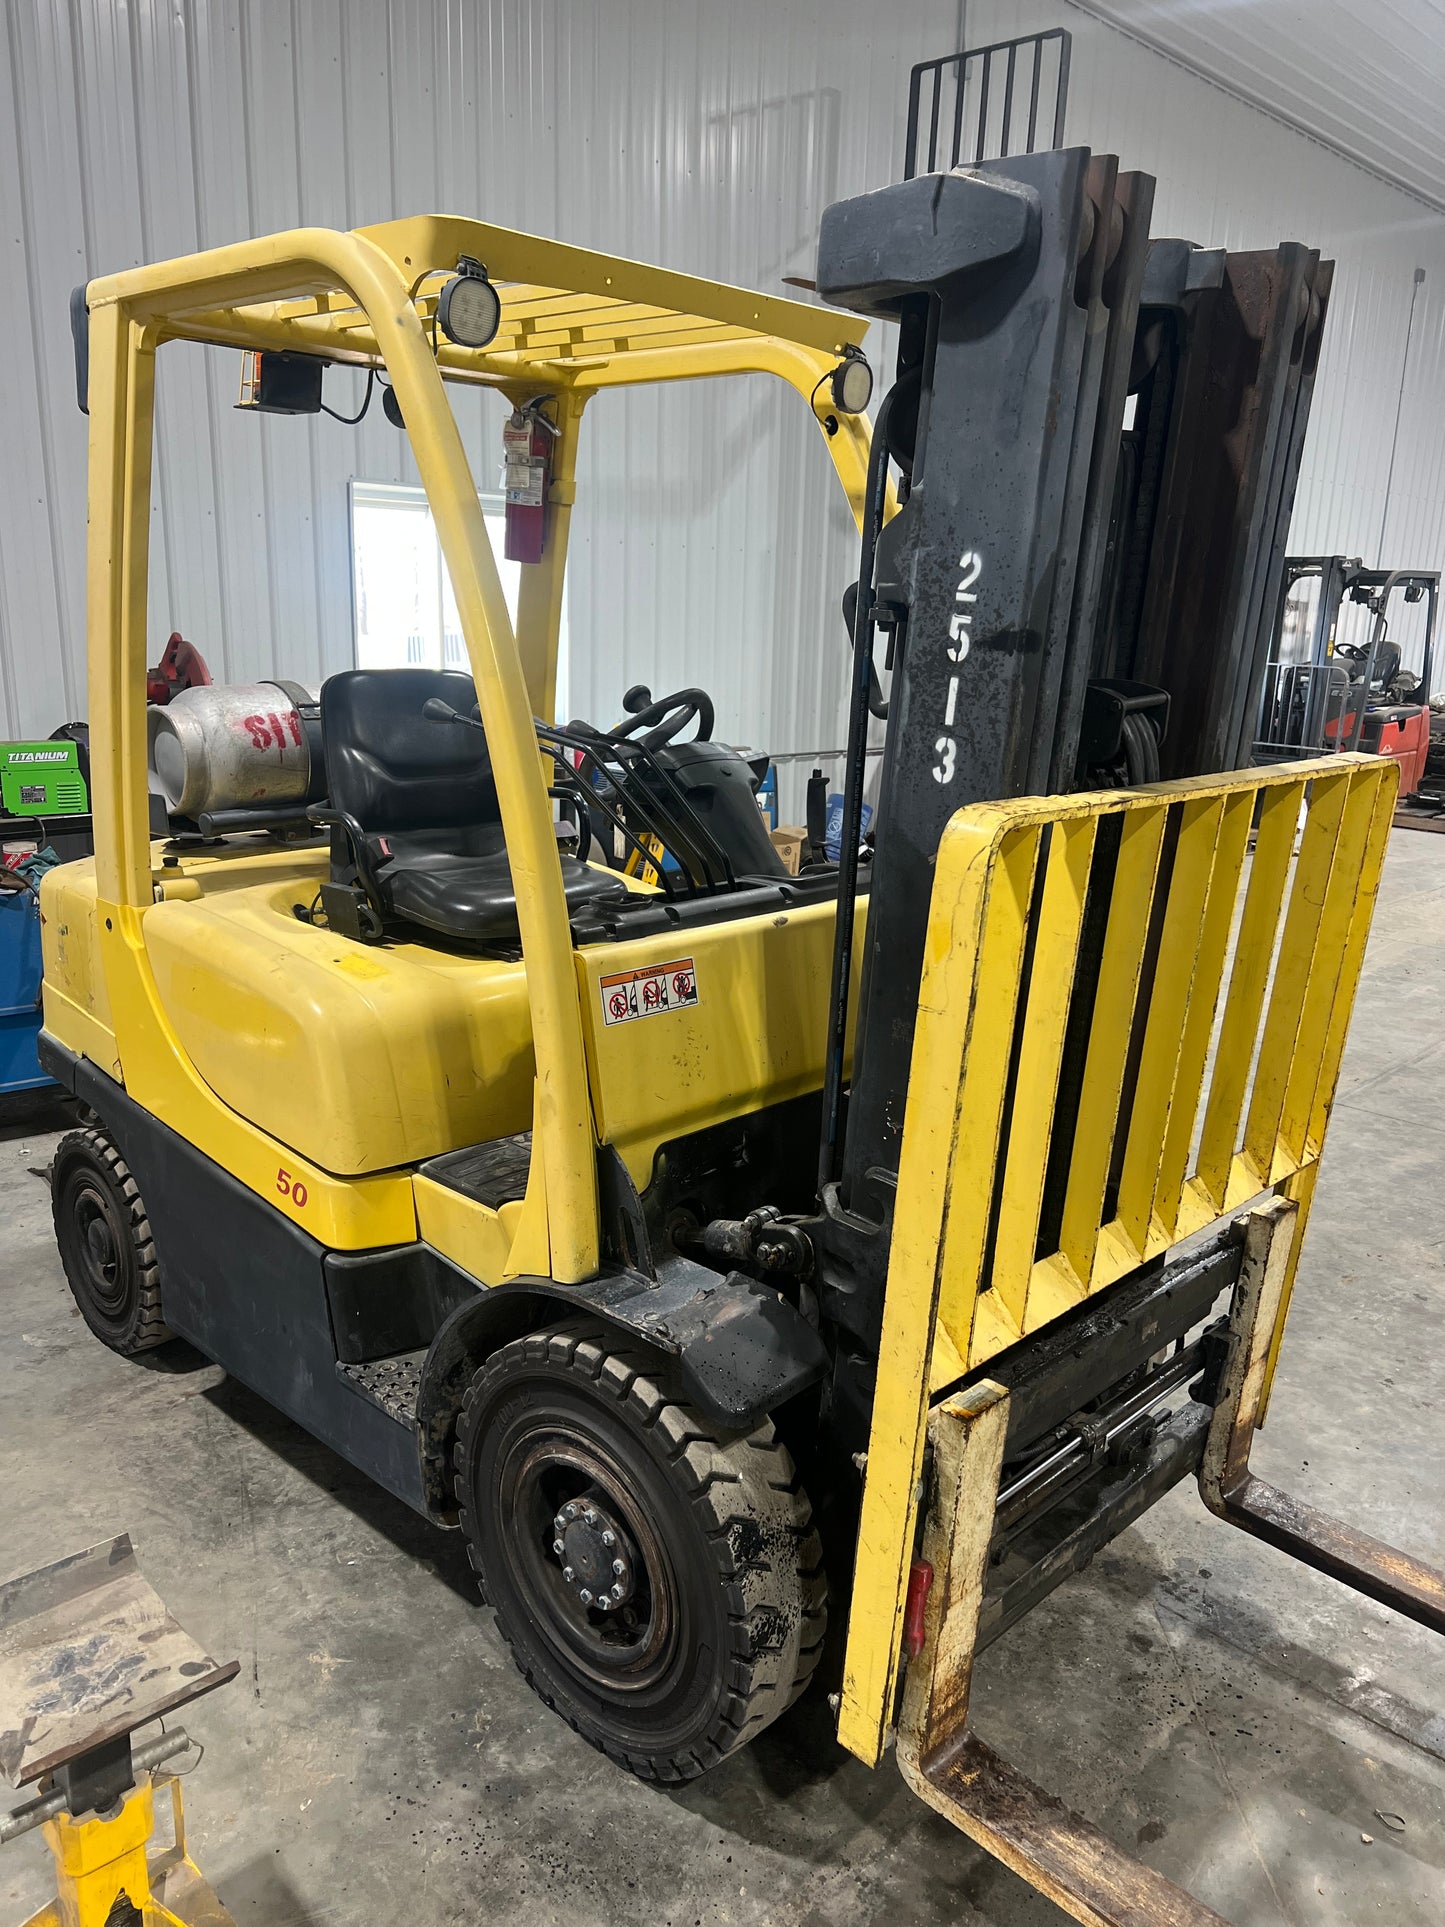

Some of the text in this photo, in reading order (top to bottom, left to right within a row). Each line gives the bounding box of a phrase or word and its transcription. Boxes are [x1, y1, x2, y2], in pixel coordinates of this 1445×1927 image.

[932, 551, 982, 784] 2513
[8, 751, 69, 762] TITANIUM
[640, 967, 665, 978] WARNING
[276, 1167, 308, 1208] 50
